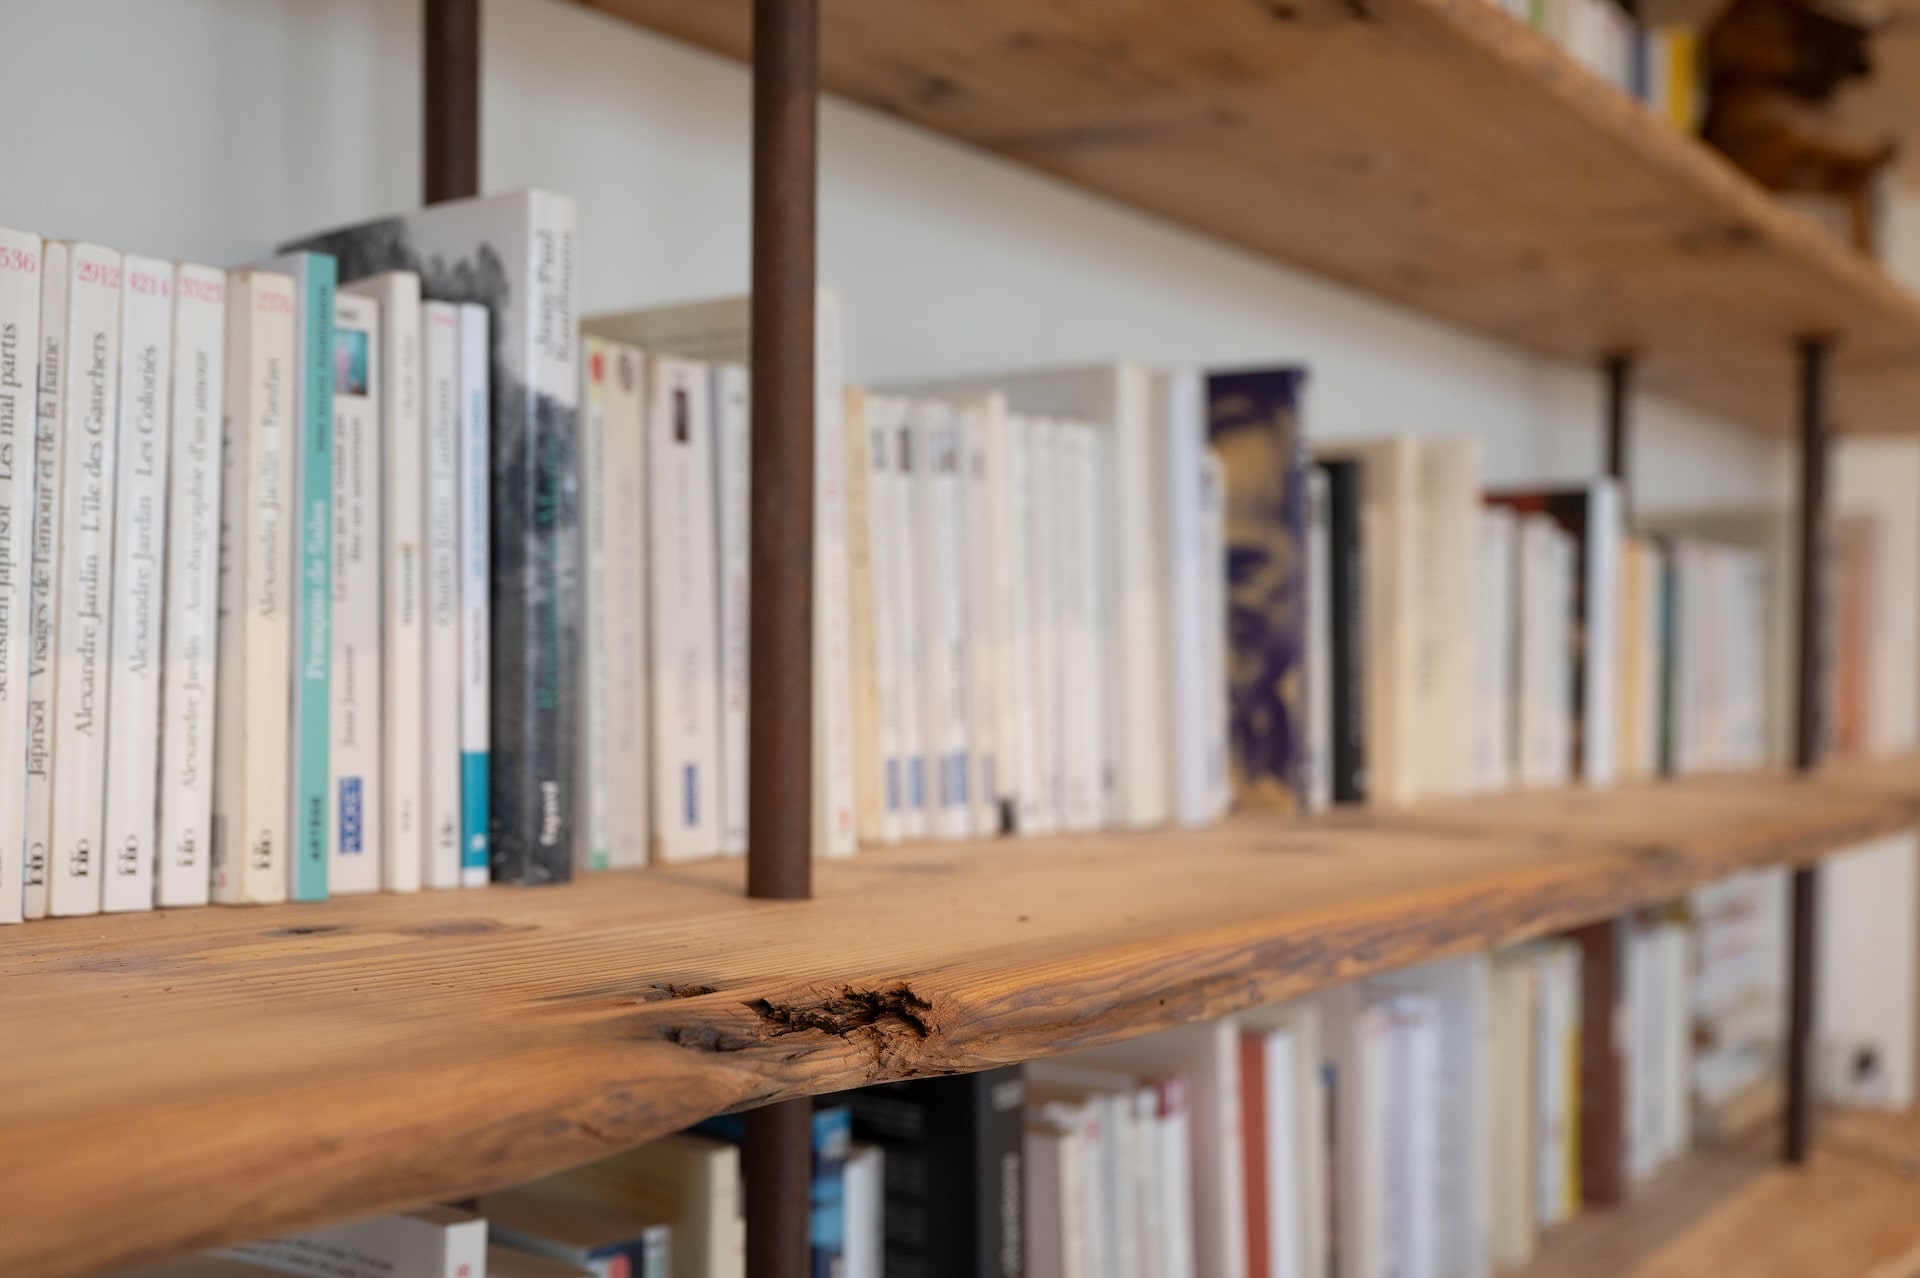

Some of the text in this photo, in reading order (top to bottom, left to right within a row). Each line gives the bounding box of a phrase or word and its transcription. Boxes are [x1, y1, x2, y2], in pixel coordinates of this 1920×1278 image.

[76, 258, 122, 289] 2912
[0, 323, 22, 481] Les mal partis
[83, 330, 107, 436] Gauchers
[83, 442, 103, 478] des
[135, 441, 156, 478] Les
[260, 450, 283, 514] Jardin
[27, 336, 59, 781] Japrisot Visages de l'amour et de la haine
[133, 496, 156, 565] Jardin
[78, 555, 101, 622] Jardin
[258, 521, 278, 619] Alexandre
[304, 499, 330, 681] François de Sales
[129, 568, 150, 679] Alexandre
[74, 624, 96, 737] Alexandre
[182, 634, 205, 695] Jardin
[180, 697, 199, 791] Alexandre
[341, 779, 359, 853] POCKET
[538, 781, 562, 846] fayard
[69, 838, 90, 878] folio
[117, 834, 138, 877] folio
[174, 828, 196, 869] folio
[252, 828, 273, 871] folio
